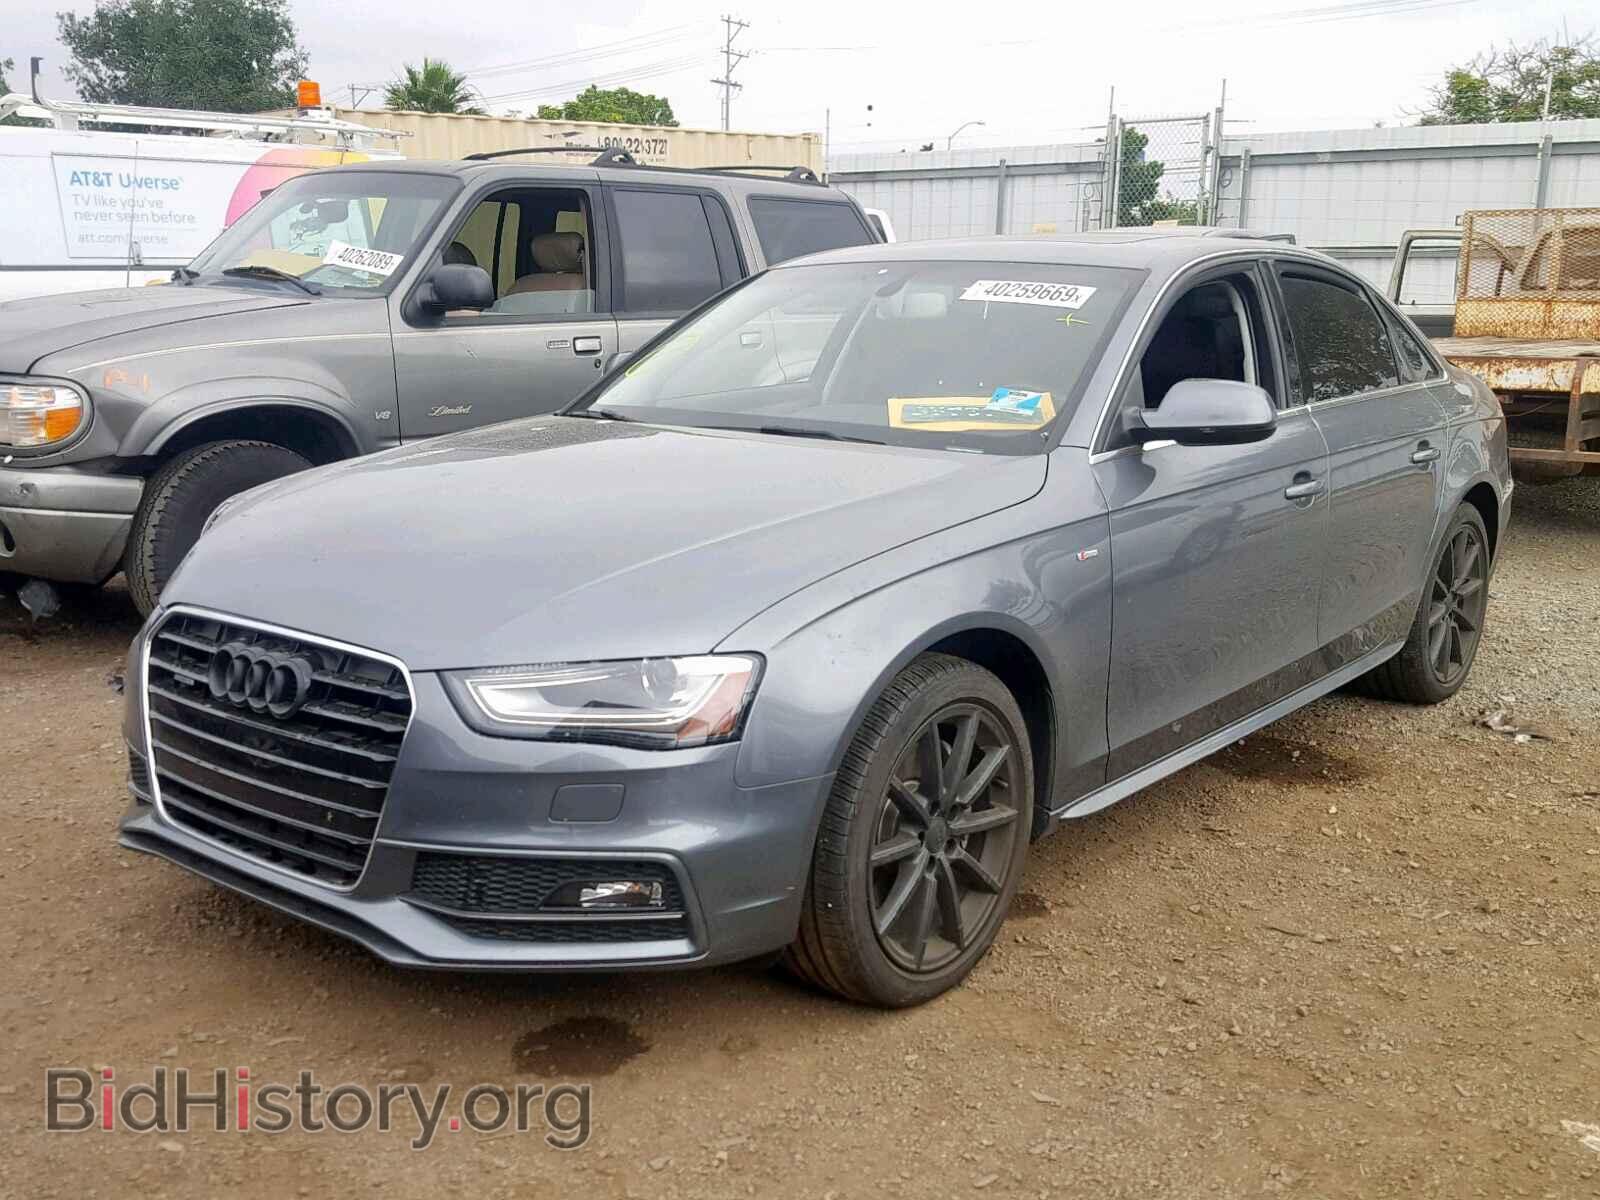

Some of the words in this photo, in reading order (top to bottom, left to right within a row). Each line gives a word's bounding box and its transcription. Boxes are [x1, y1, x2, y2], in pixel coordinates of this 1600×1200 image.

[69, 170, 112, 188] AT&T
[71, 193, 91, 207] TV
[93, 192, 117, 208] like
[120, 197, 164, 210] you've
[73, 211, 112, 222] never
[116, 212, 149, 224] seen
[151, 210, 197, 225] before
[375, 410, 392, 420] V8
